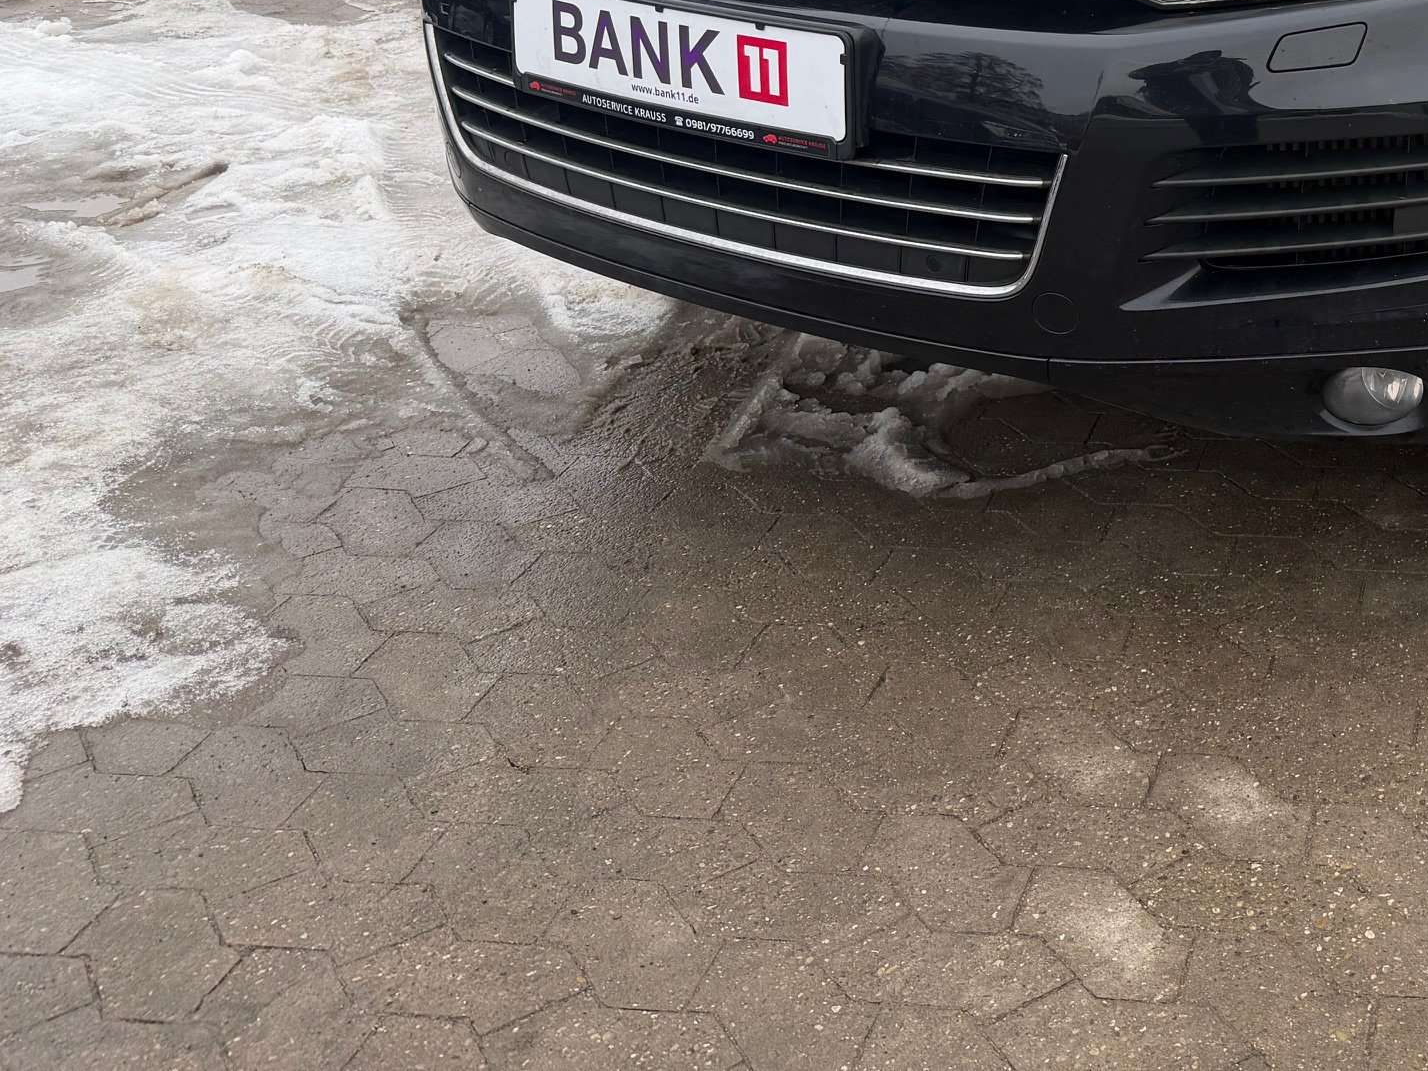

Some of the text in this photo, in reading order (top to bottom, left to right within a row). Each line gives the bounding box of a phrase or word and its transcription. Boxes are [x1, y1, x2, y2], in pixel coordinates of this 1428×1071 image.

[551, 0, 783, 99] BANK 11
[631, 83, 699, 104] www.bank11.de
[582, 94, 755, 140] AUTOSERVICE KRAUSS 0981/97766699
